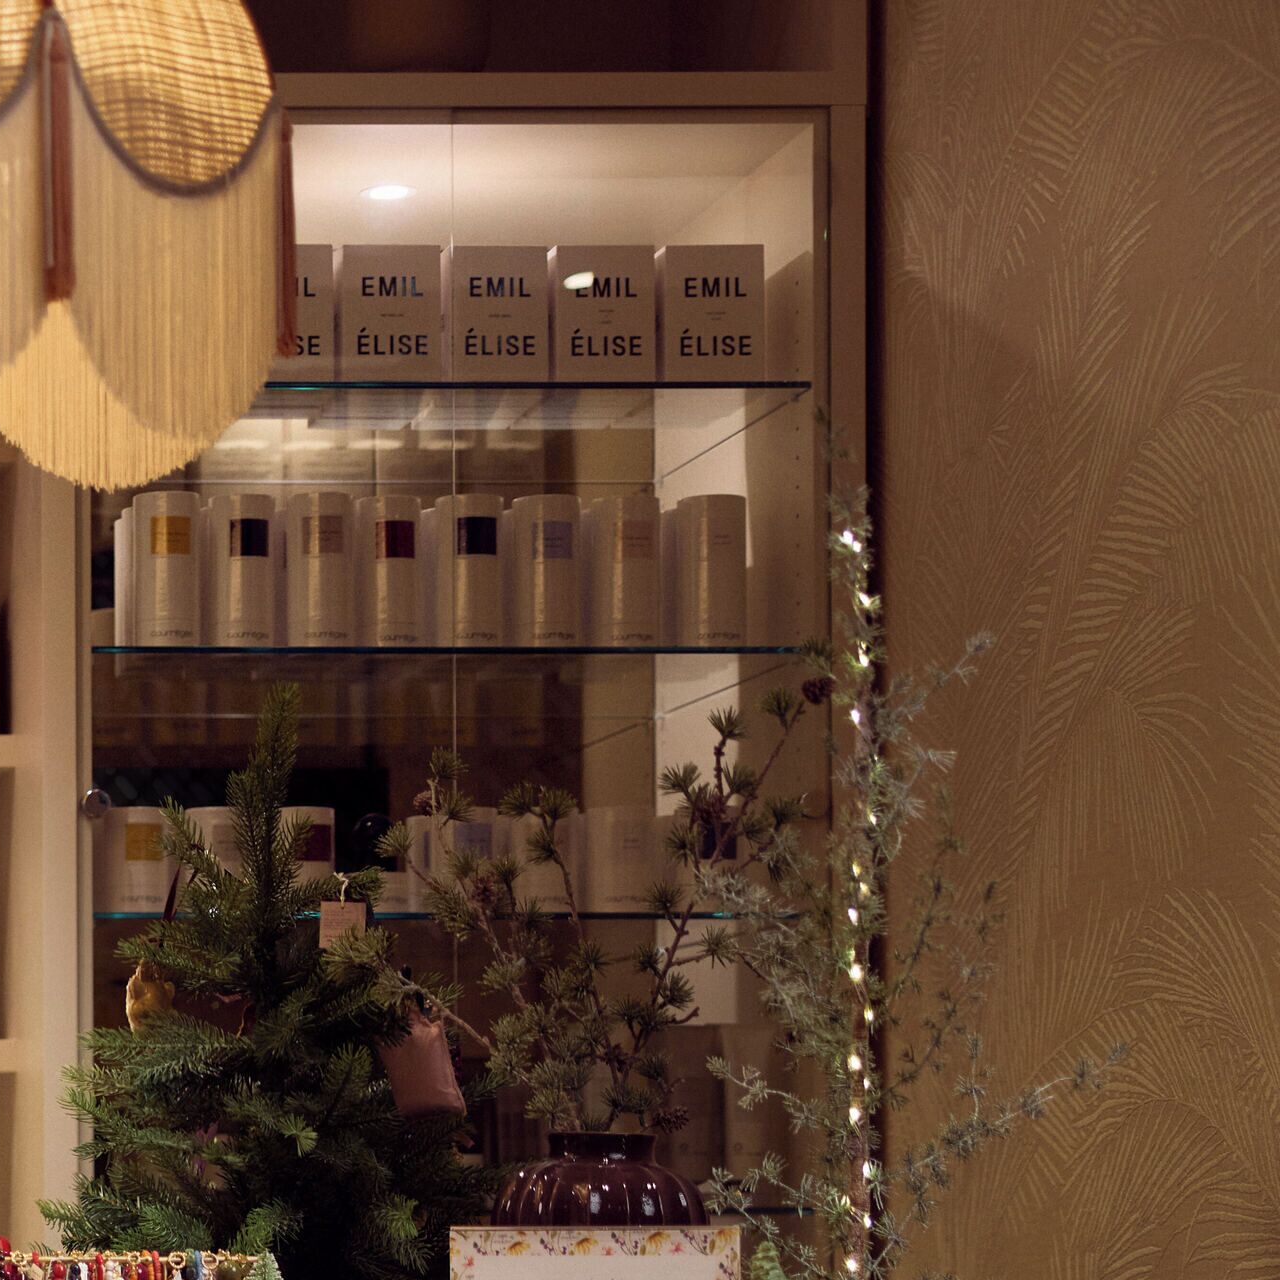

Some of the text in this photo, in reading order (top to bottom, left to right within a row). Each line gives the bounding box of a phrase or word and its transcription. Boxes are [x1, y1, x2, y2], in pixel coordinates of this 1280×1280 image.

[361, 277, 424, 298] EMIL
[469, 277, 531, 298] EMIL
[684, 277, 747, 298] EMIL
[357, 327, 428, 357] ÉLISE
[464, 327, 536, 357] ÉLISE
[570, 328, 643, 357] ÉLISE
[679, 328, 752, 357] ÉLISE
